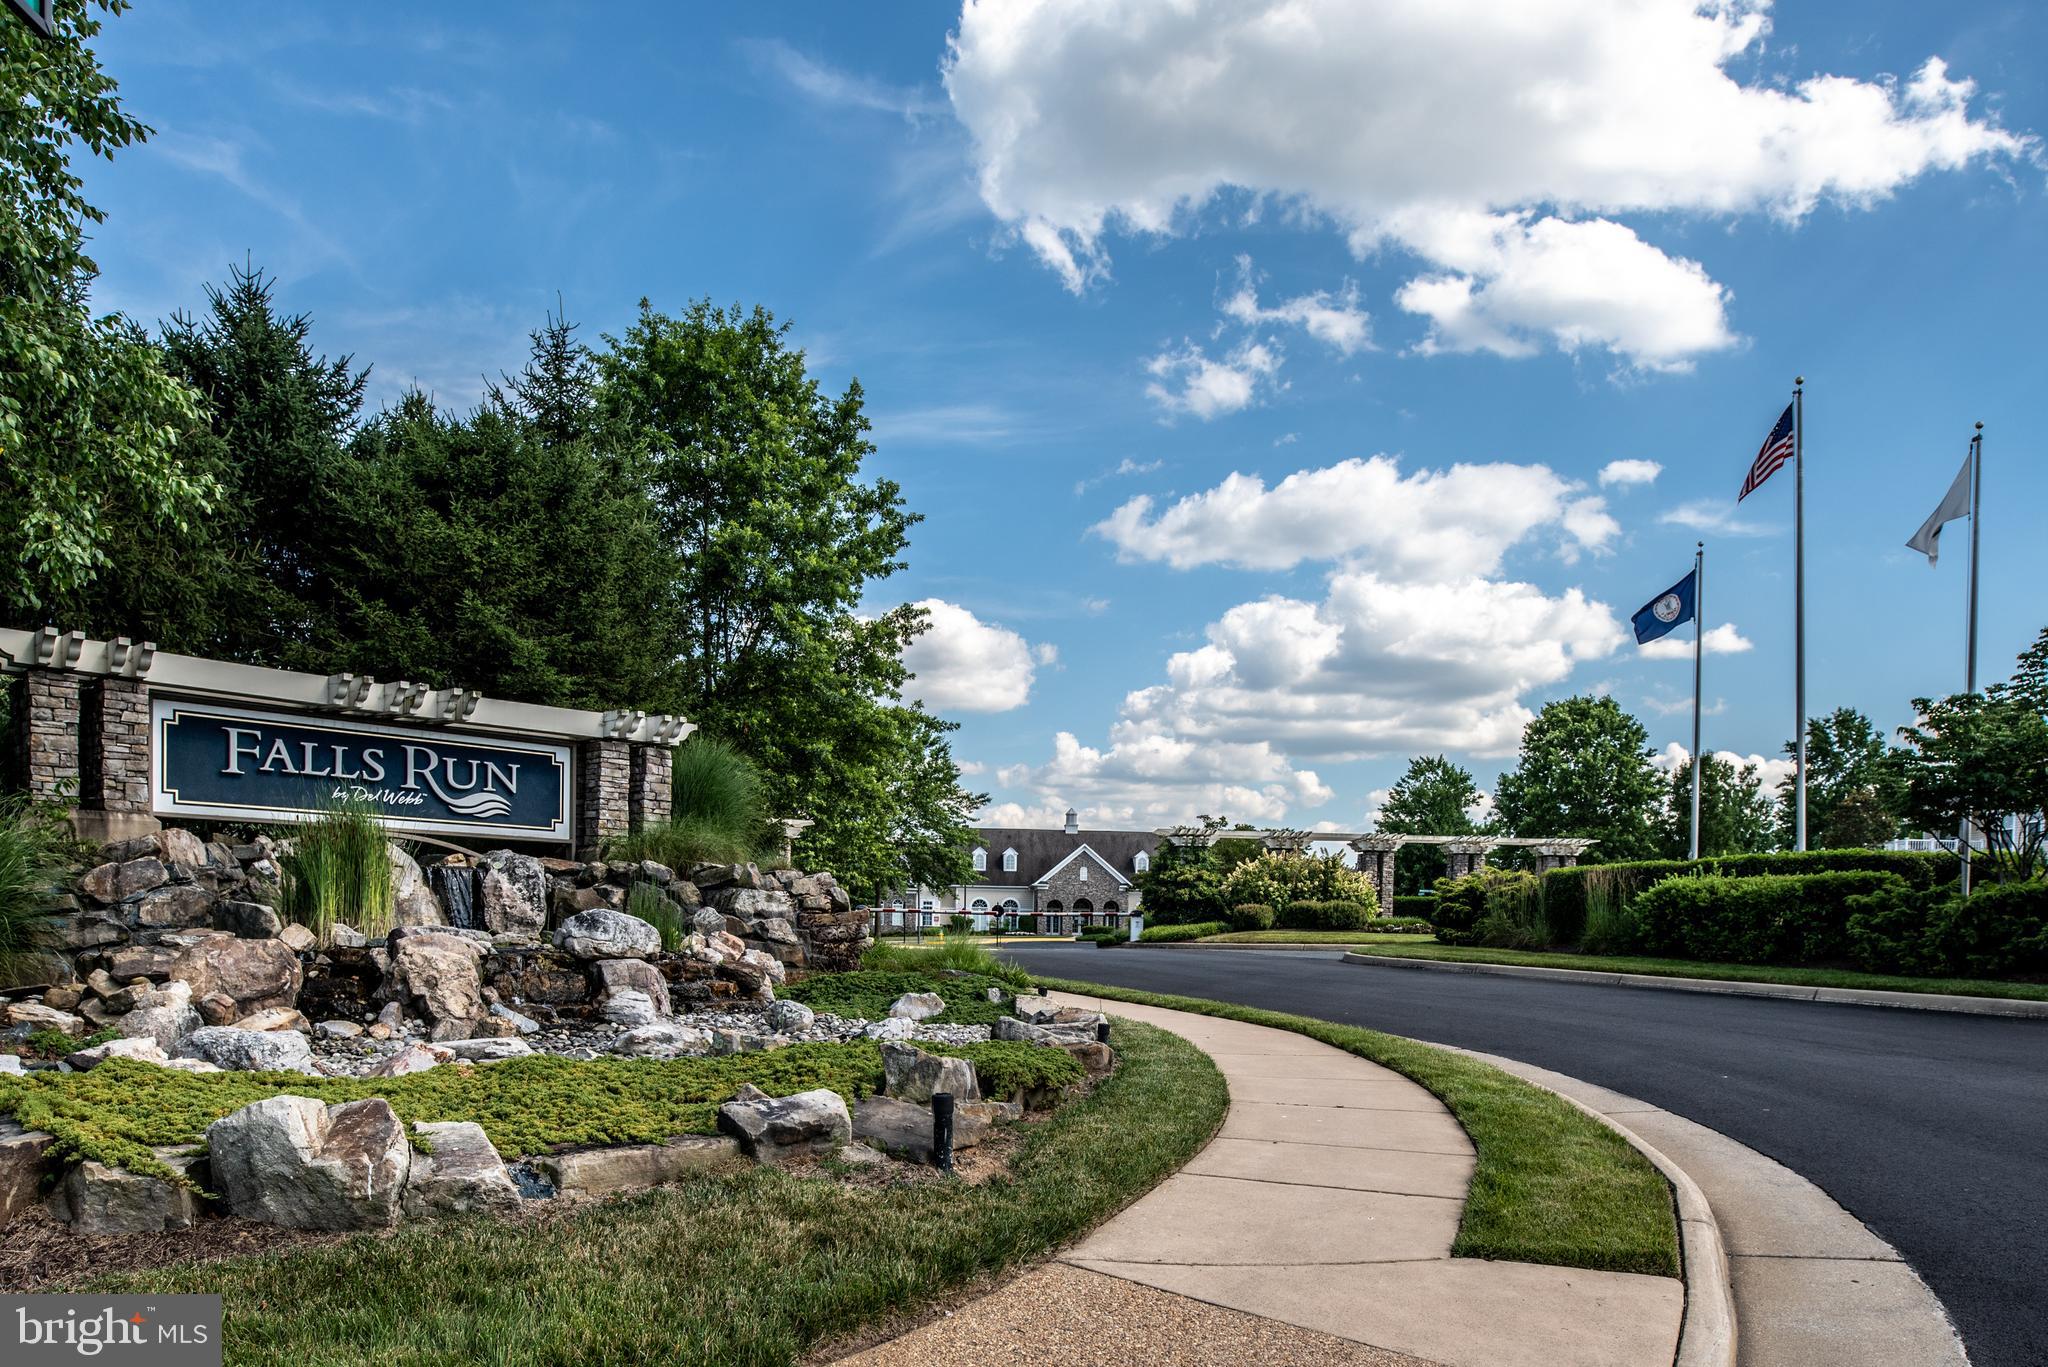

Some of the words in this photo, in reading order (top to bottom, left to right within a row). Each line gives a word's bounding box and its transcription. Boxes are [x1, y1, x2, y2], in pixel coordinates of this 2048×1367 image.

[221, 726, 386, 782] FALLS
[400, 744, 521, 807] RUN
[331, 785, 350, 806] by
[350, 785, 383, 802] Del
[382, 788, 424, 806] Webb
